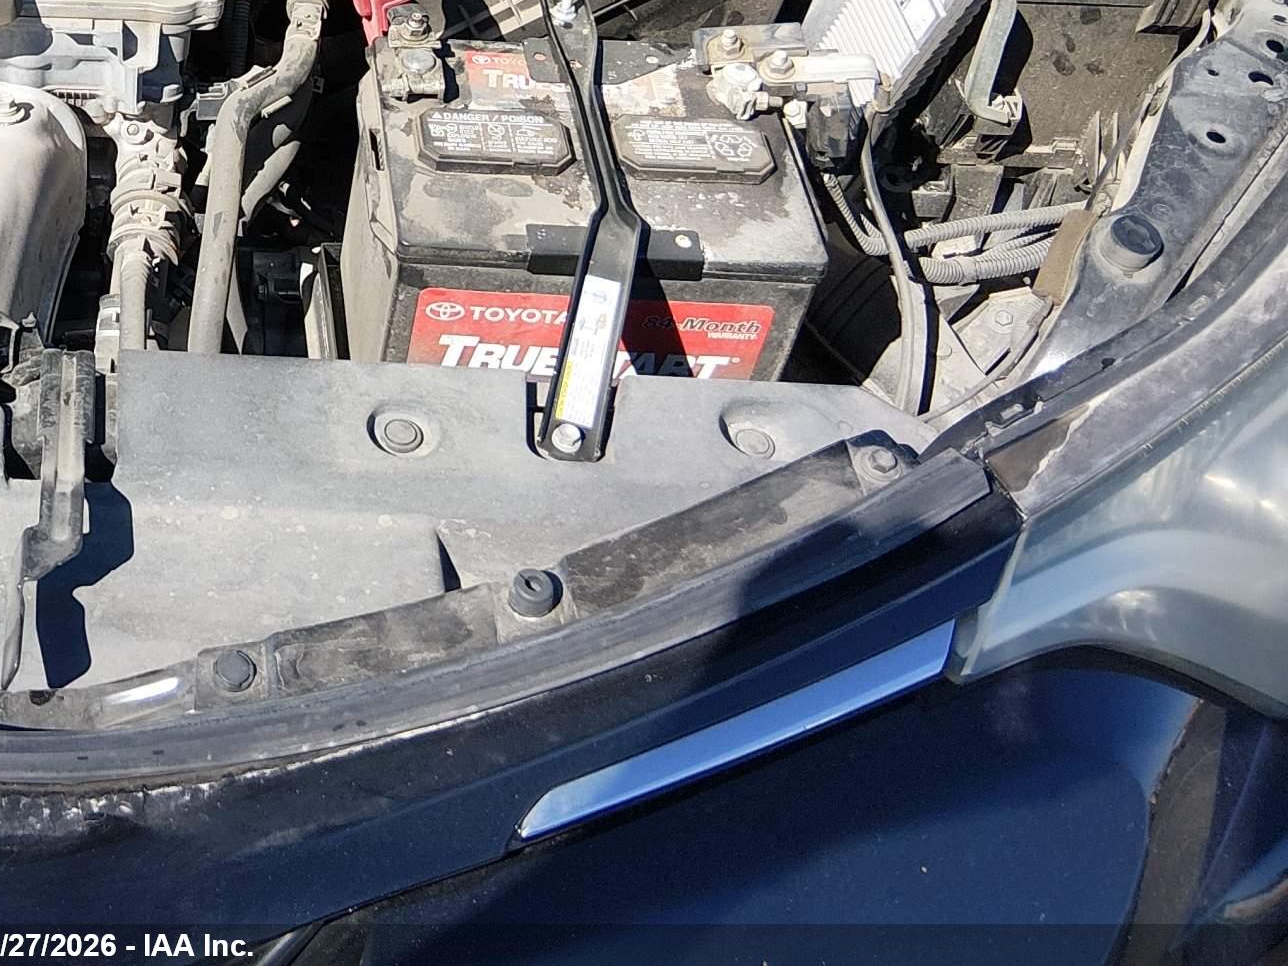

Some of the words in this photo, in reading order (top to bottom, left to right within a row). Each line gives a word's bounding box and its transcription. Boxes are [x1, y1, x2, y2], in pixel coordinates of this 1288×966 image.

[443, 112, 489, 121] DANGER
[503, 114, 544, 124] POISON
[470, 306, 567, 325] TOYOTA
